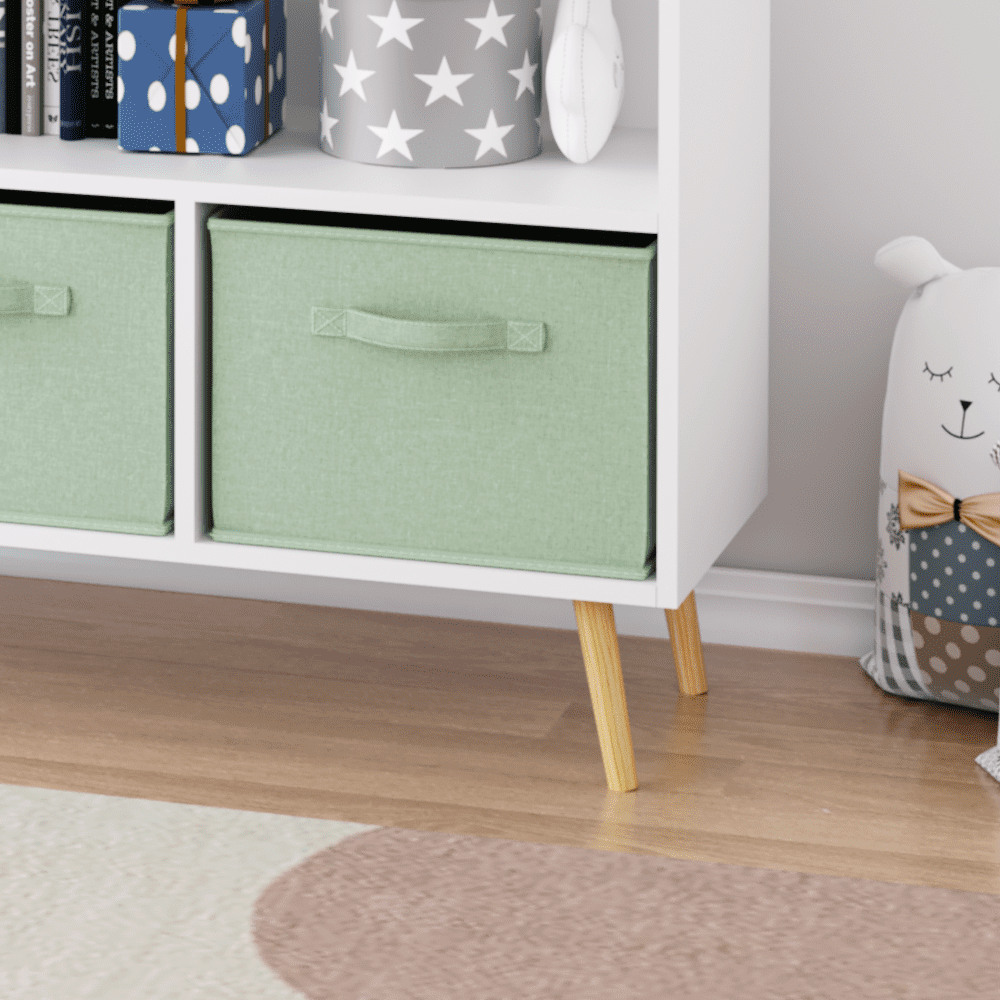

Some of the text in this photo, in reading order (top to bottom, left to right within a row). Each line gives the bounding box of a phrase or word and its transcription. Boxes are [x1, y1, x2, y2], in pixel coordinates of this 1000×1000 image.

[91, 13, 100, 27] &
[105, 13, 114, 28] &
[25, 41, 35, 60] on
[91, 30, 100, 99] ARTISTS
[105, 30, 114, 100] ARTISTS
[25, 64, 37, 88] Art
